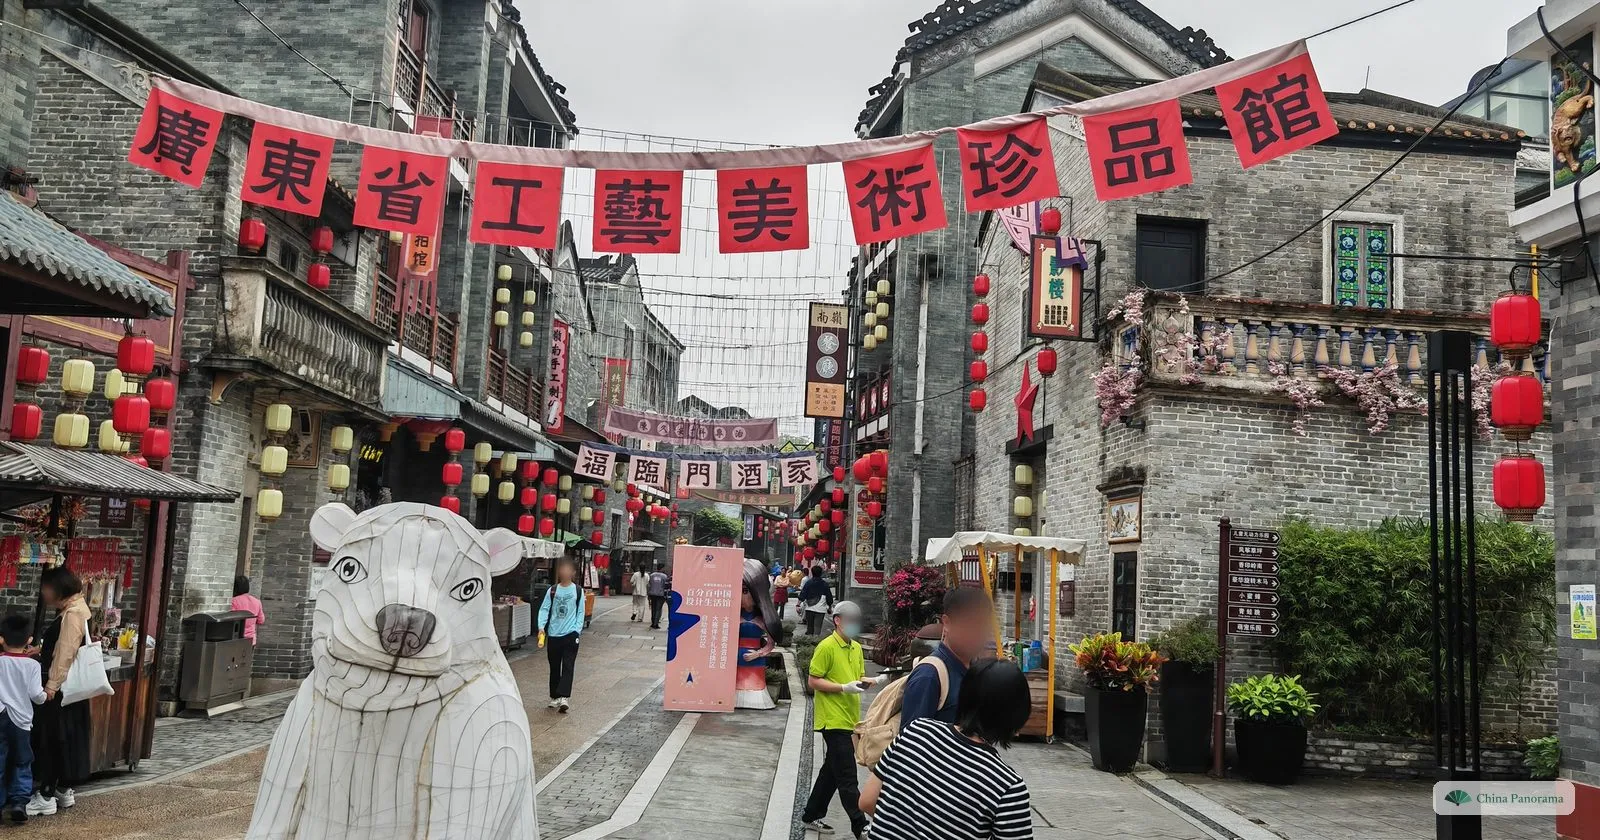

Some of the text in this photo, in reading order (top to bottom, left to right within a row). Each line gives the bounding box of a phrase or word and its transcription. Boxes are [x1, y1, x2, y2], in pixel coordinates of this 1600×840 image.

[139, 72, 1321, 249] 廣東省工藝美術珍品館
[582, 449, 812, 487] 福臨門酒家
[1238, 546, 1263, 554] 风筝草坪
[1232, 576, 1269, 585] 豪华旋转木马
[687, 588, 732, 598] 百分百中国
[1239, 592, 1261, 600] 小蜜蜂
[686, 597, 731, 607] 设计生活馆
